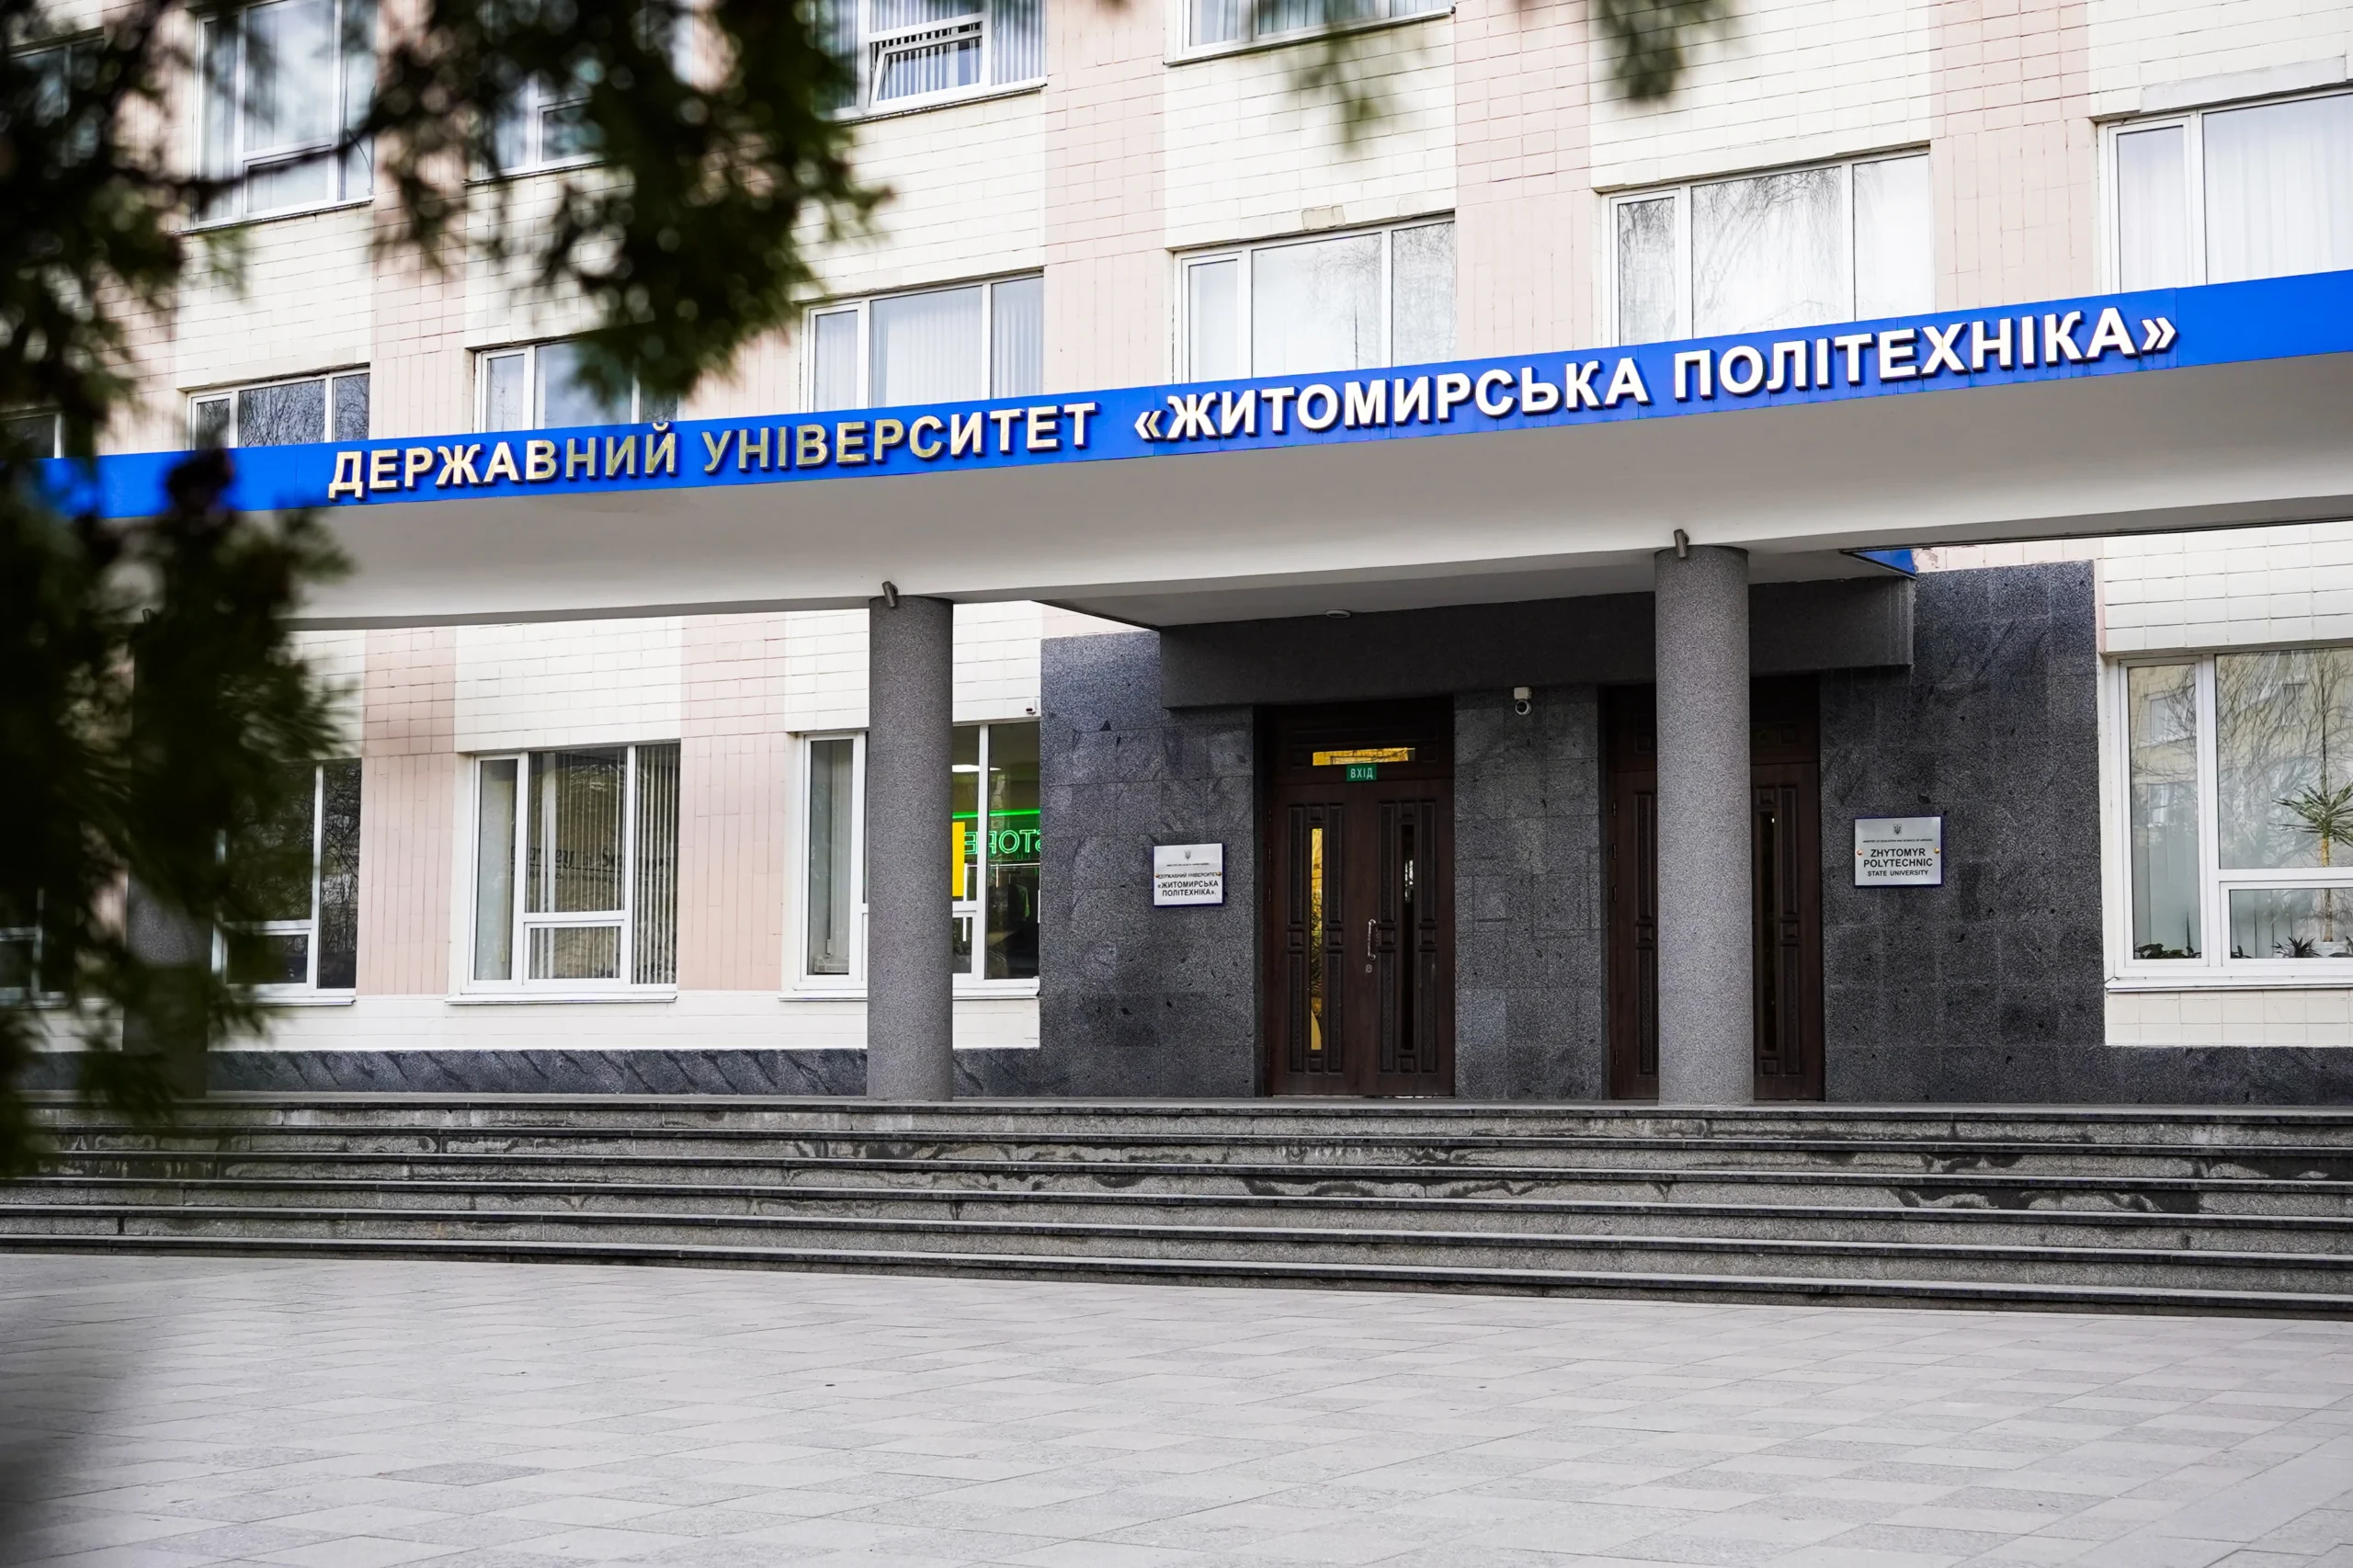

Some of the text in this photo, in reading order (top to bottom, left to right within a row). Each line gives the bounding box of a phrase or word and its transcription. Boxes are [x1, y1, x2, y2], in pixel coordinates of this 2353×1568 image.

[328, 306, 2177, 501] ДЕРЖАВНИЙ УНІВЕРСИТЕТ «ЖИТОМИРСЬКА ПОЛІТЕХНІКА»
[1350, 767, 1373, 779] ВХІД
[1870, 847, 1926, 858] ZHYTOMYR
[1863, 858, 1933, 868] POLYTECHNIC
[1157, 880, 1219, 889] «ЖИТОМИРСЬКА
